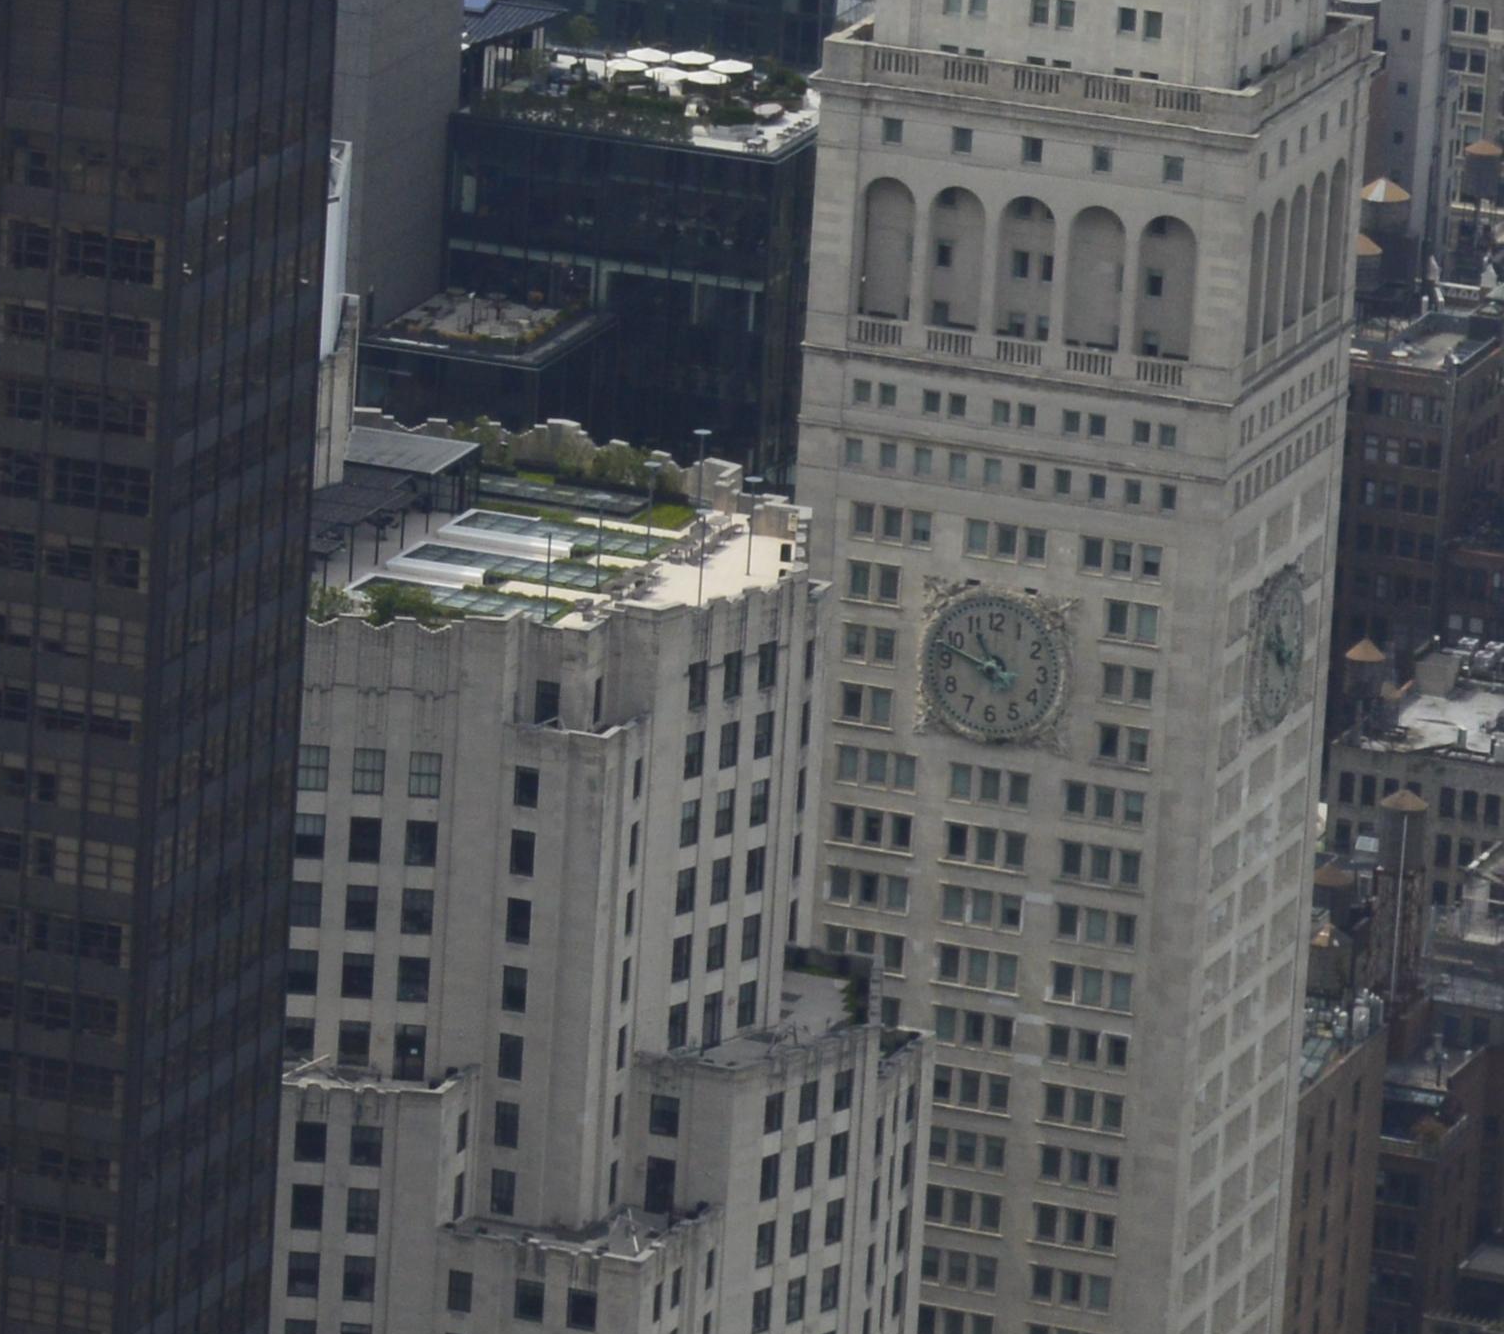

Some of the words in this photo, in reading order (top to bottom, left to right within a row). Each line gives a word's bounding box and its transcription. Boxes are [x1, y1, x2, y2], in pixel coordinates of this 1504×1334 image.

[968, 615, 981, 634] 11
[988, 612, 1005, 632] 12
[1015, 621, 1022, 641] 1
[948, 630, 964, 649] 10
[1029, 641, 1042, 660] 2
[940, 651, 952, 670] 9
[945, 675, 957, 693] 8
[1036, 666, 1048, 684] 3
[962, 693, 975, 714] 7
[1026, 688, 1038, 707] 4
[983, 704, 996, 723] 6
[1007, 702, 1020, 721] 5
